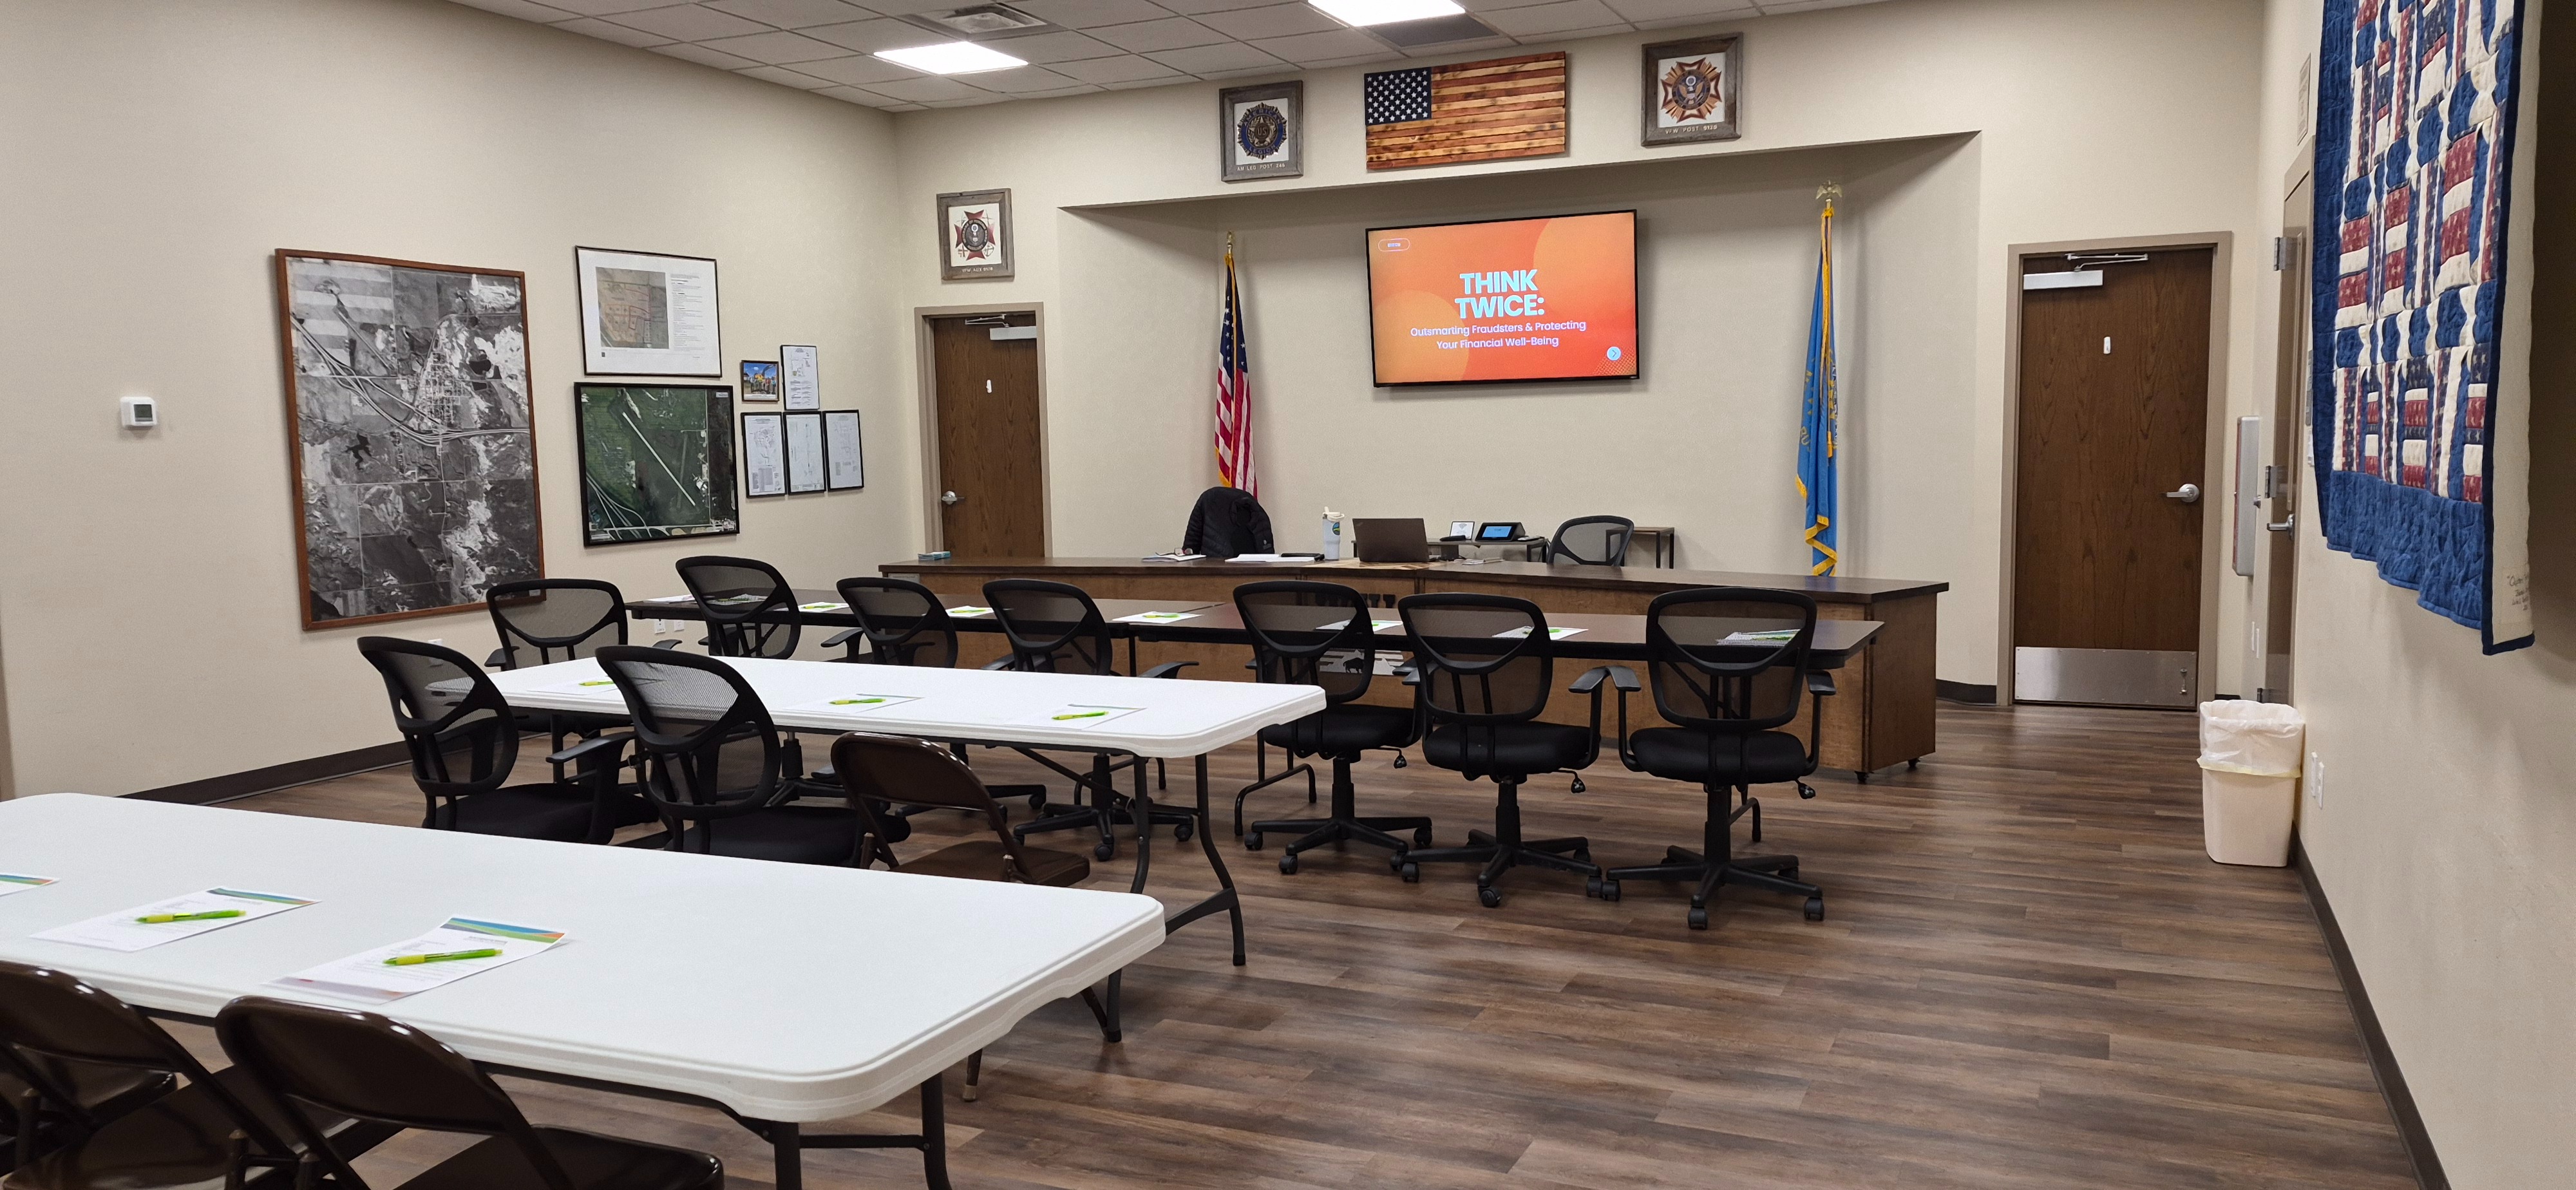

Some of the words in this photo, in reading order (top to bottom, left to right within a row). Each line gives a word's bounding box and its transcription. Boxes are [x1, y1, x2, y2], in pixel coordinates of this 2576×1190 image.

[1243, 109, 1280, 127] AMERICAN
[1258, 127, 1267, 136] US
[1249, 144, 1275, 153] LEGION
[1459, 269, 1539, 294] THINK
[1454, 294, 1545, 319] TWICE:
[1410, 325, 1470, 337] Outsmarting
[1472, 323, 1523, 334] Fraudsters
[1525, 322, 1533, 332] &
[1535, 320, 1586, 332] Protecting
[1436, 341, 1458, 349] Your
[1459, 338, 1503, 348] Financial
[1505, 335, 1559, 347] Well-Being
